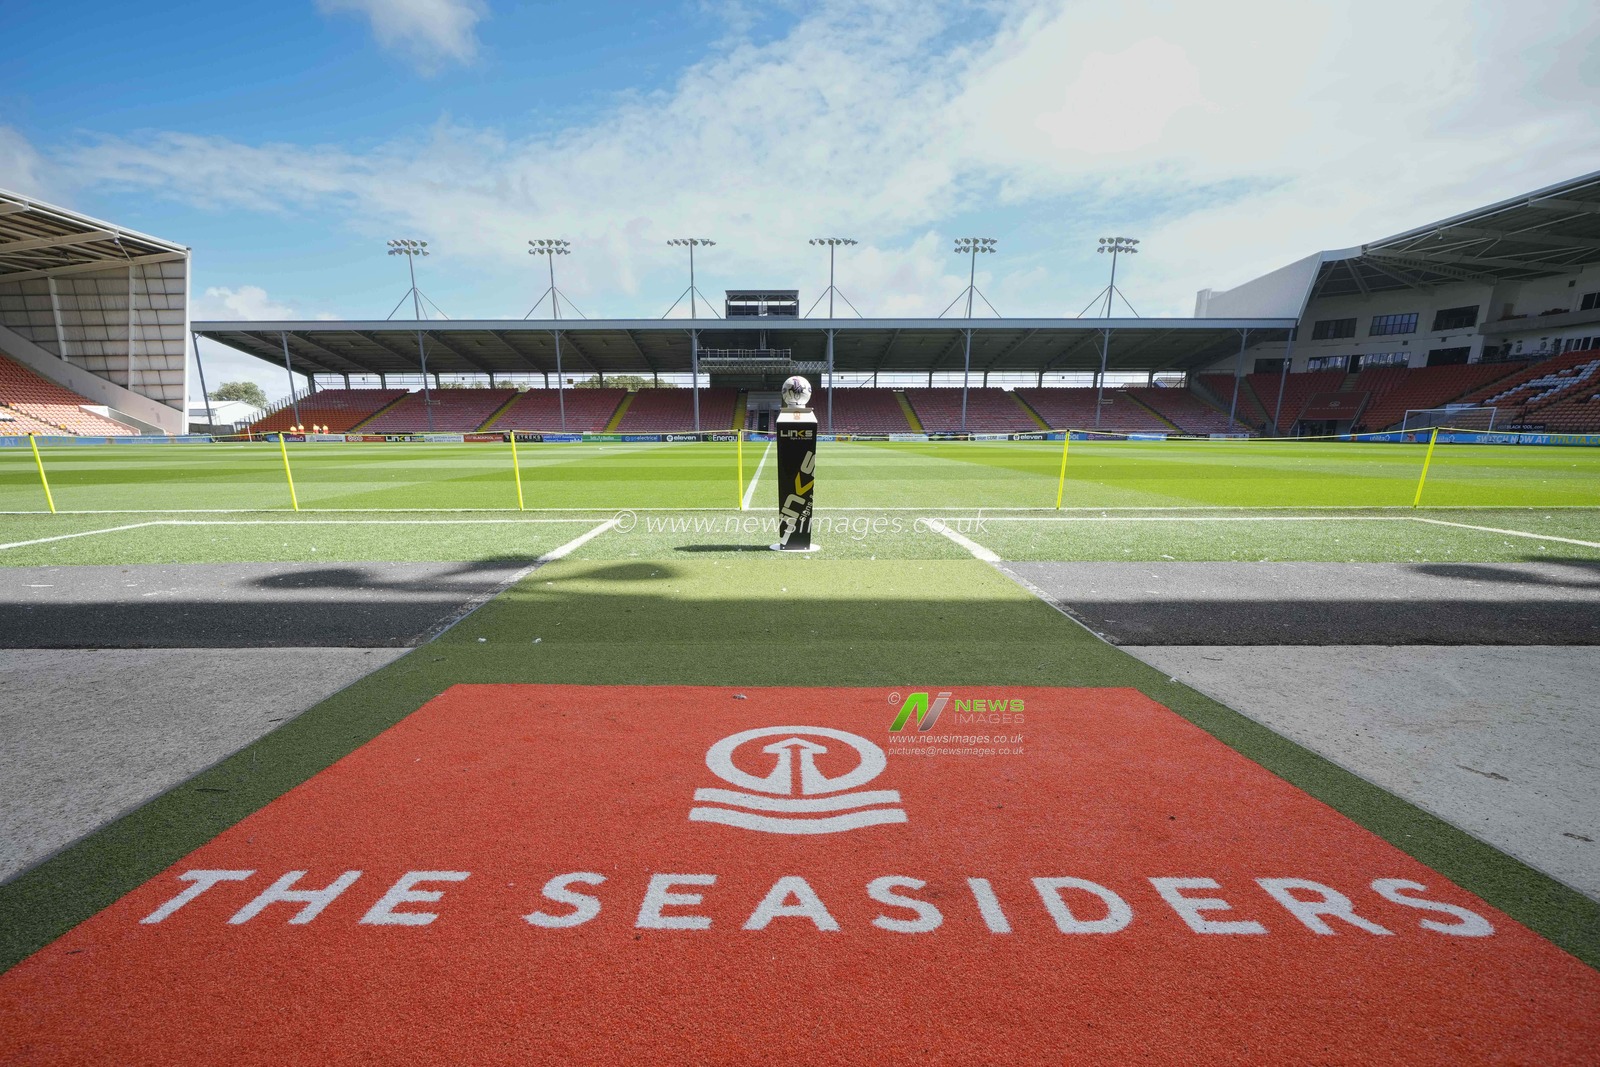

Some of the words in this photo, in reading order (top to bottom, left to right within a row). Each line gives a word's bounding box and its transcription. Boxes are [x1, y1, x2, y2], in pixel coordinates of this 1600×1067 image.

[1535, 435, 1549, 444] AT
[138, 869, 471, 926] THE
[521, 871, 1496, 938] SEASIDERS
